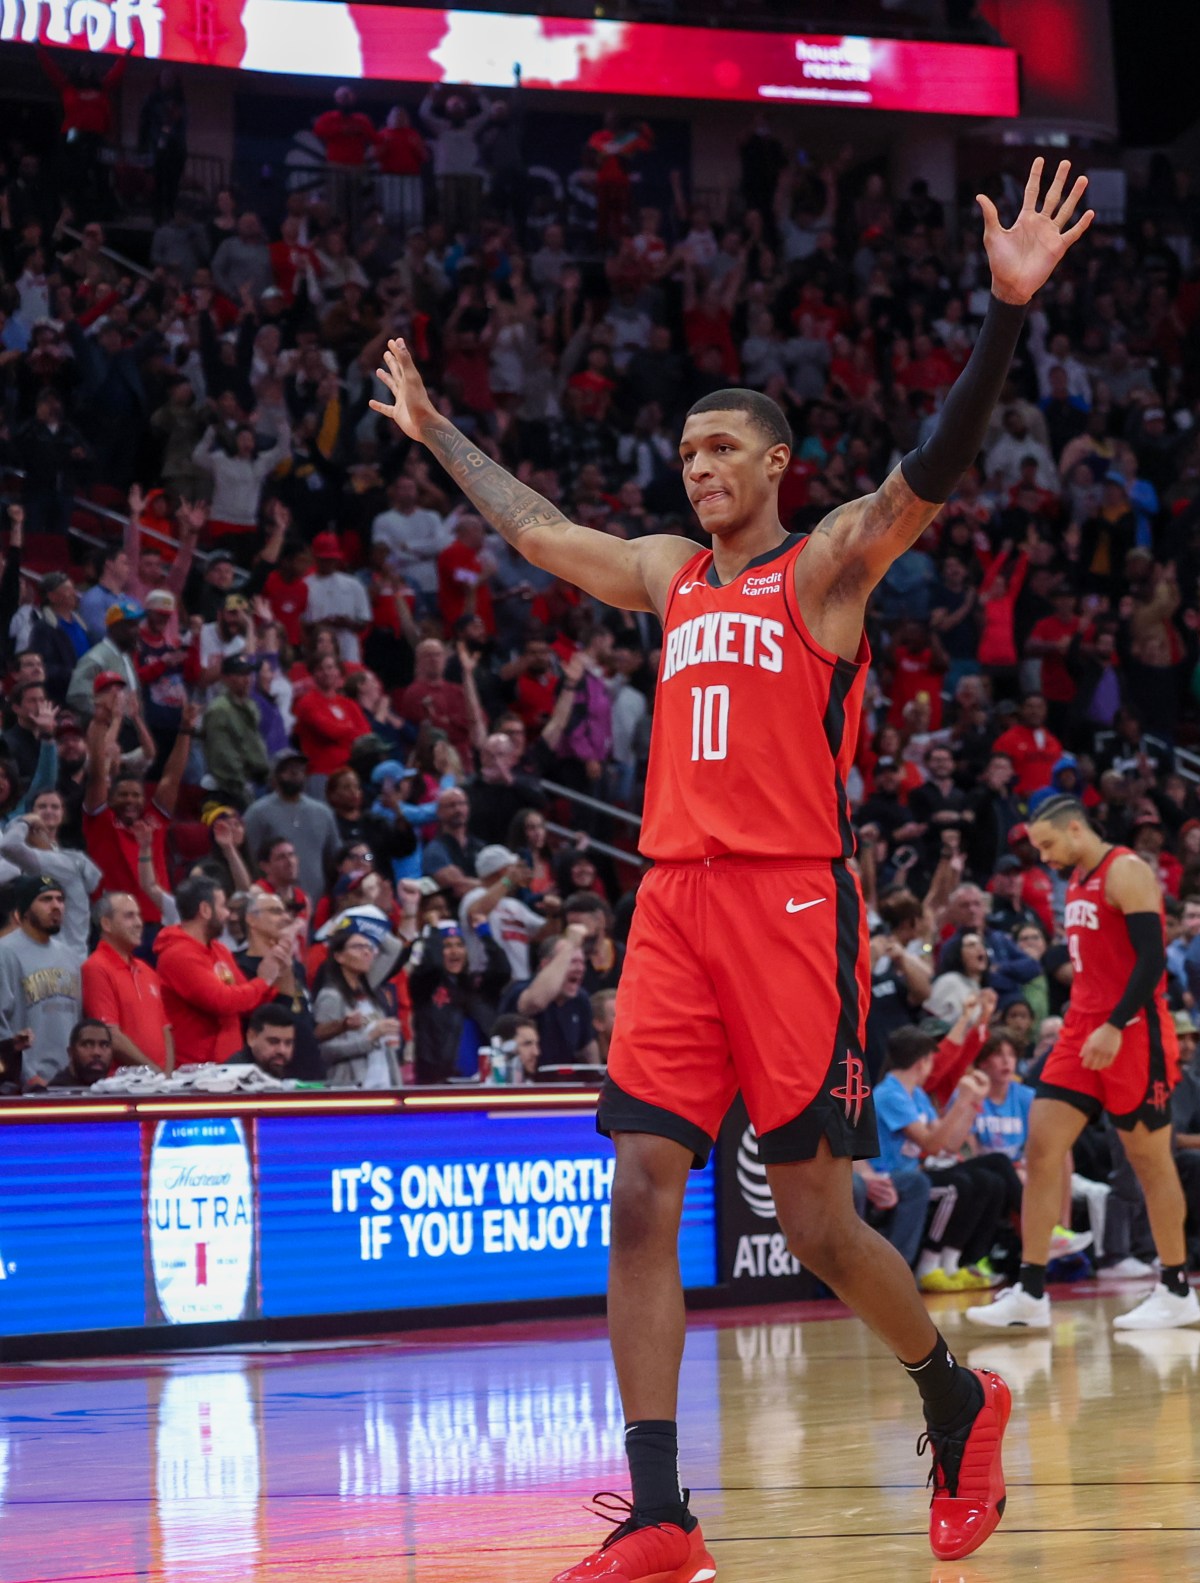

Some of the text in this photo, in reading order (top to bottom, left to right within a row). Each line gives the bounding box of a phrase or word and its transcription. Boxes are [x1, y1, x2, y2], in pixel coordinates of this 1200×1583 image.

[742, 583, 781, 596] karma
[662, 612, 784, 682] ROCKETS
[691, 684, 730, 762] 10
[153, 1194, 251, 1231] ULTRA
[331, 1157, 616, 1213] IT'S ONLY WORTH
[360, 1214, 393, 1260] IF
[399, 1210, 474, 1258] YOU
[482, 1204, 594, 1254] ENJOY
